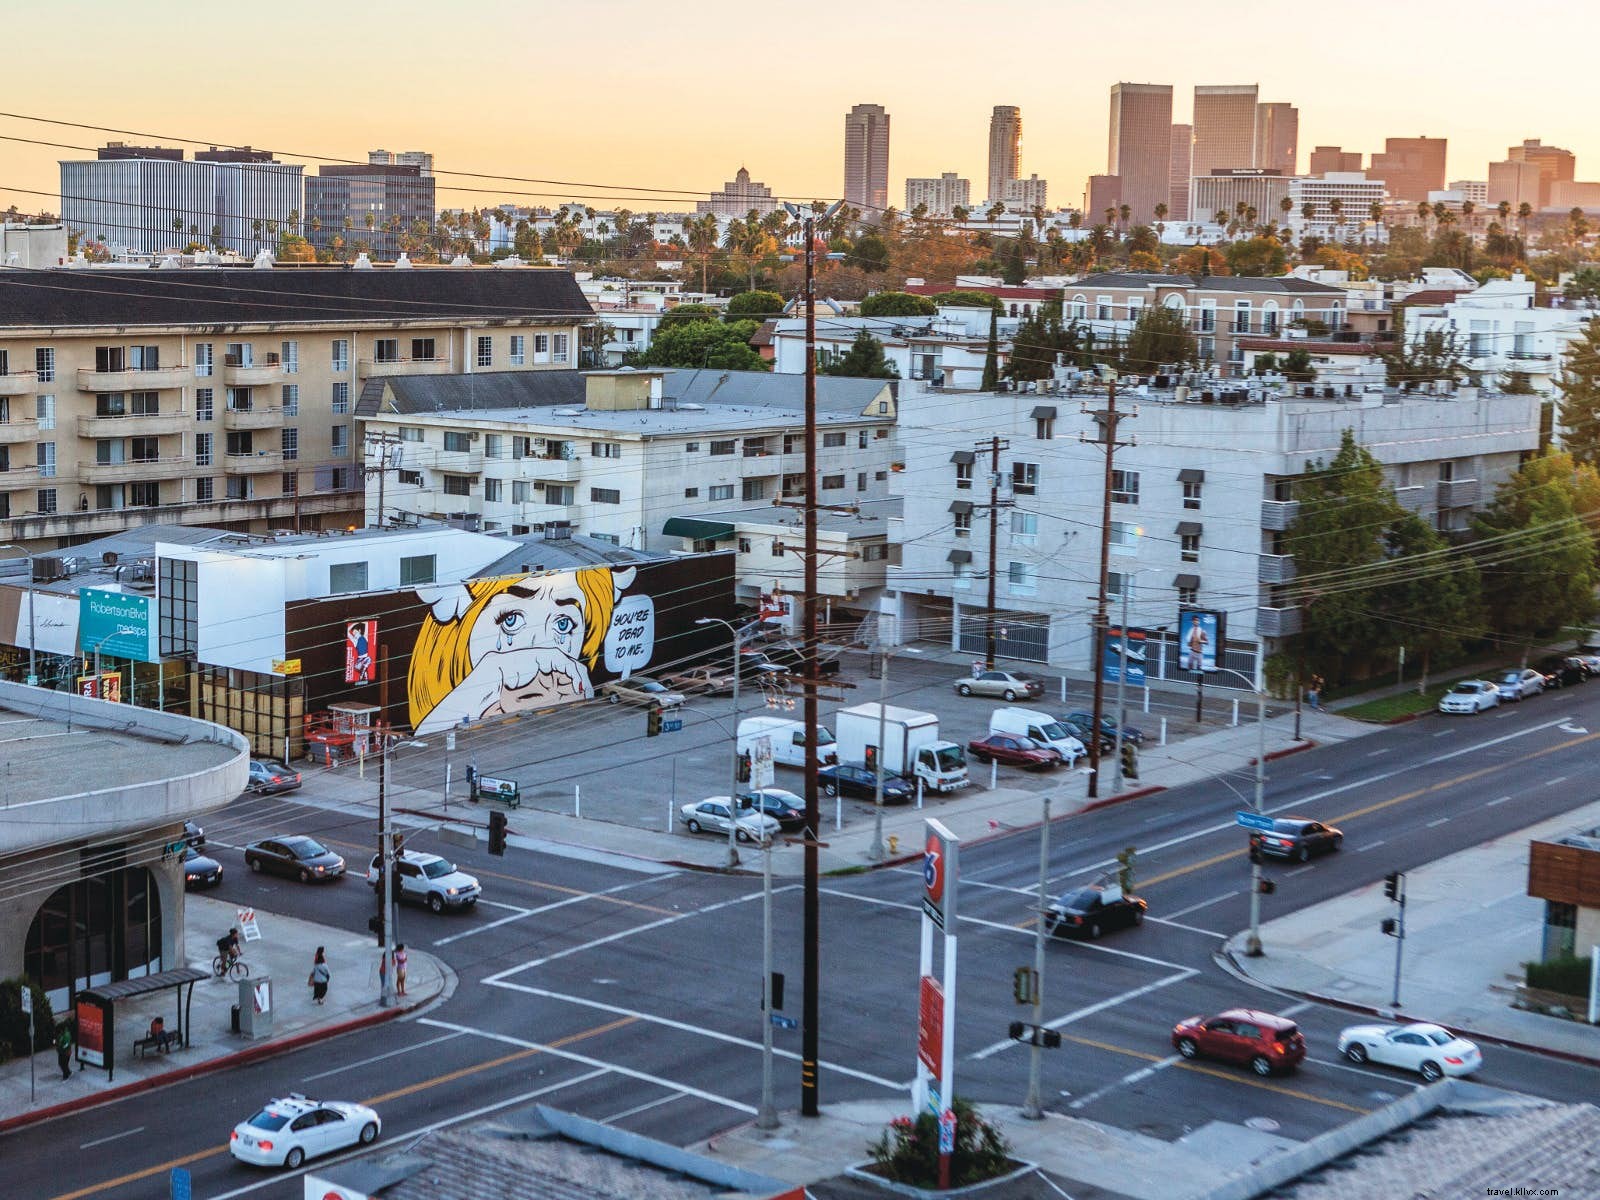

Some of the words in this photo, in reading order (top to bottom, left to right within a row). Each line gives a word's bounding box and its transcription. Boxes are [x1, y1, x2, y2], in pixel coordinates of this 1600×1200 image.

[613, 609, 650, 627] YOU'RE
[618, 625, 645, 642] DEAD
[615, 646, 626, 659] TO
